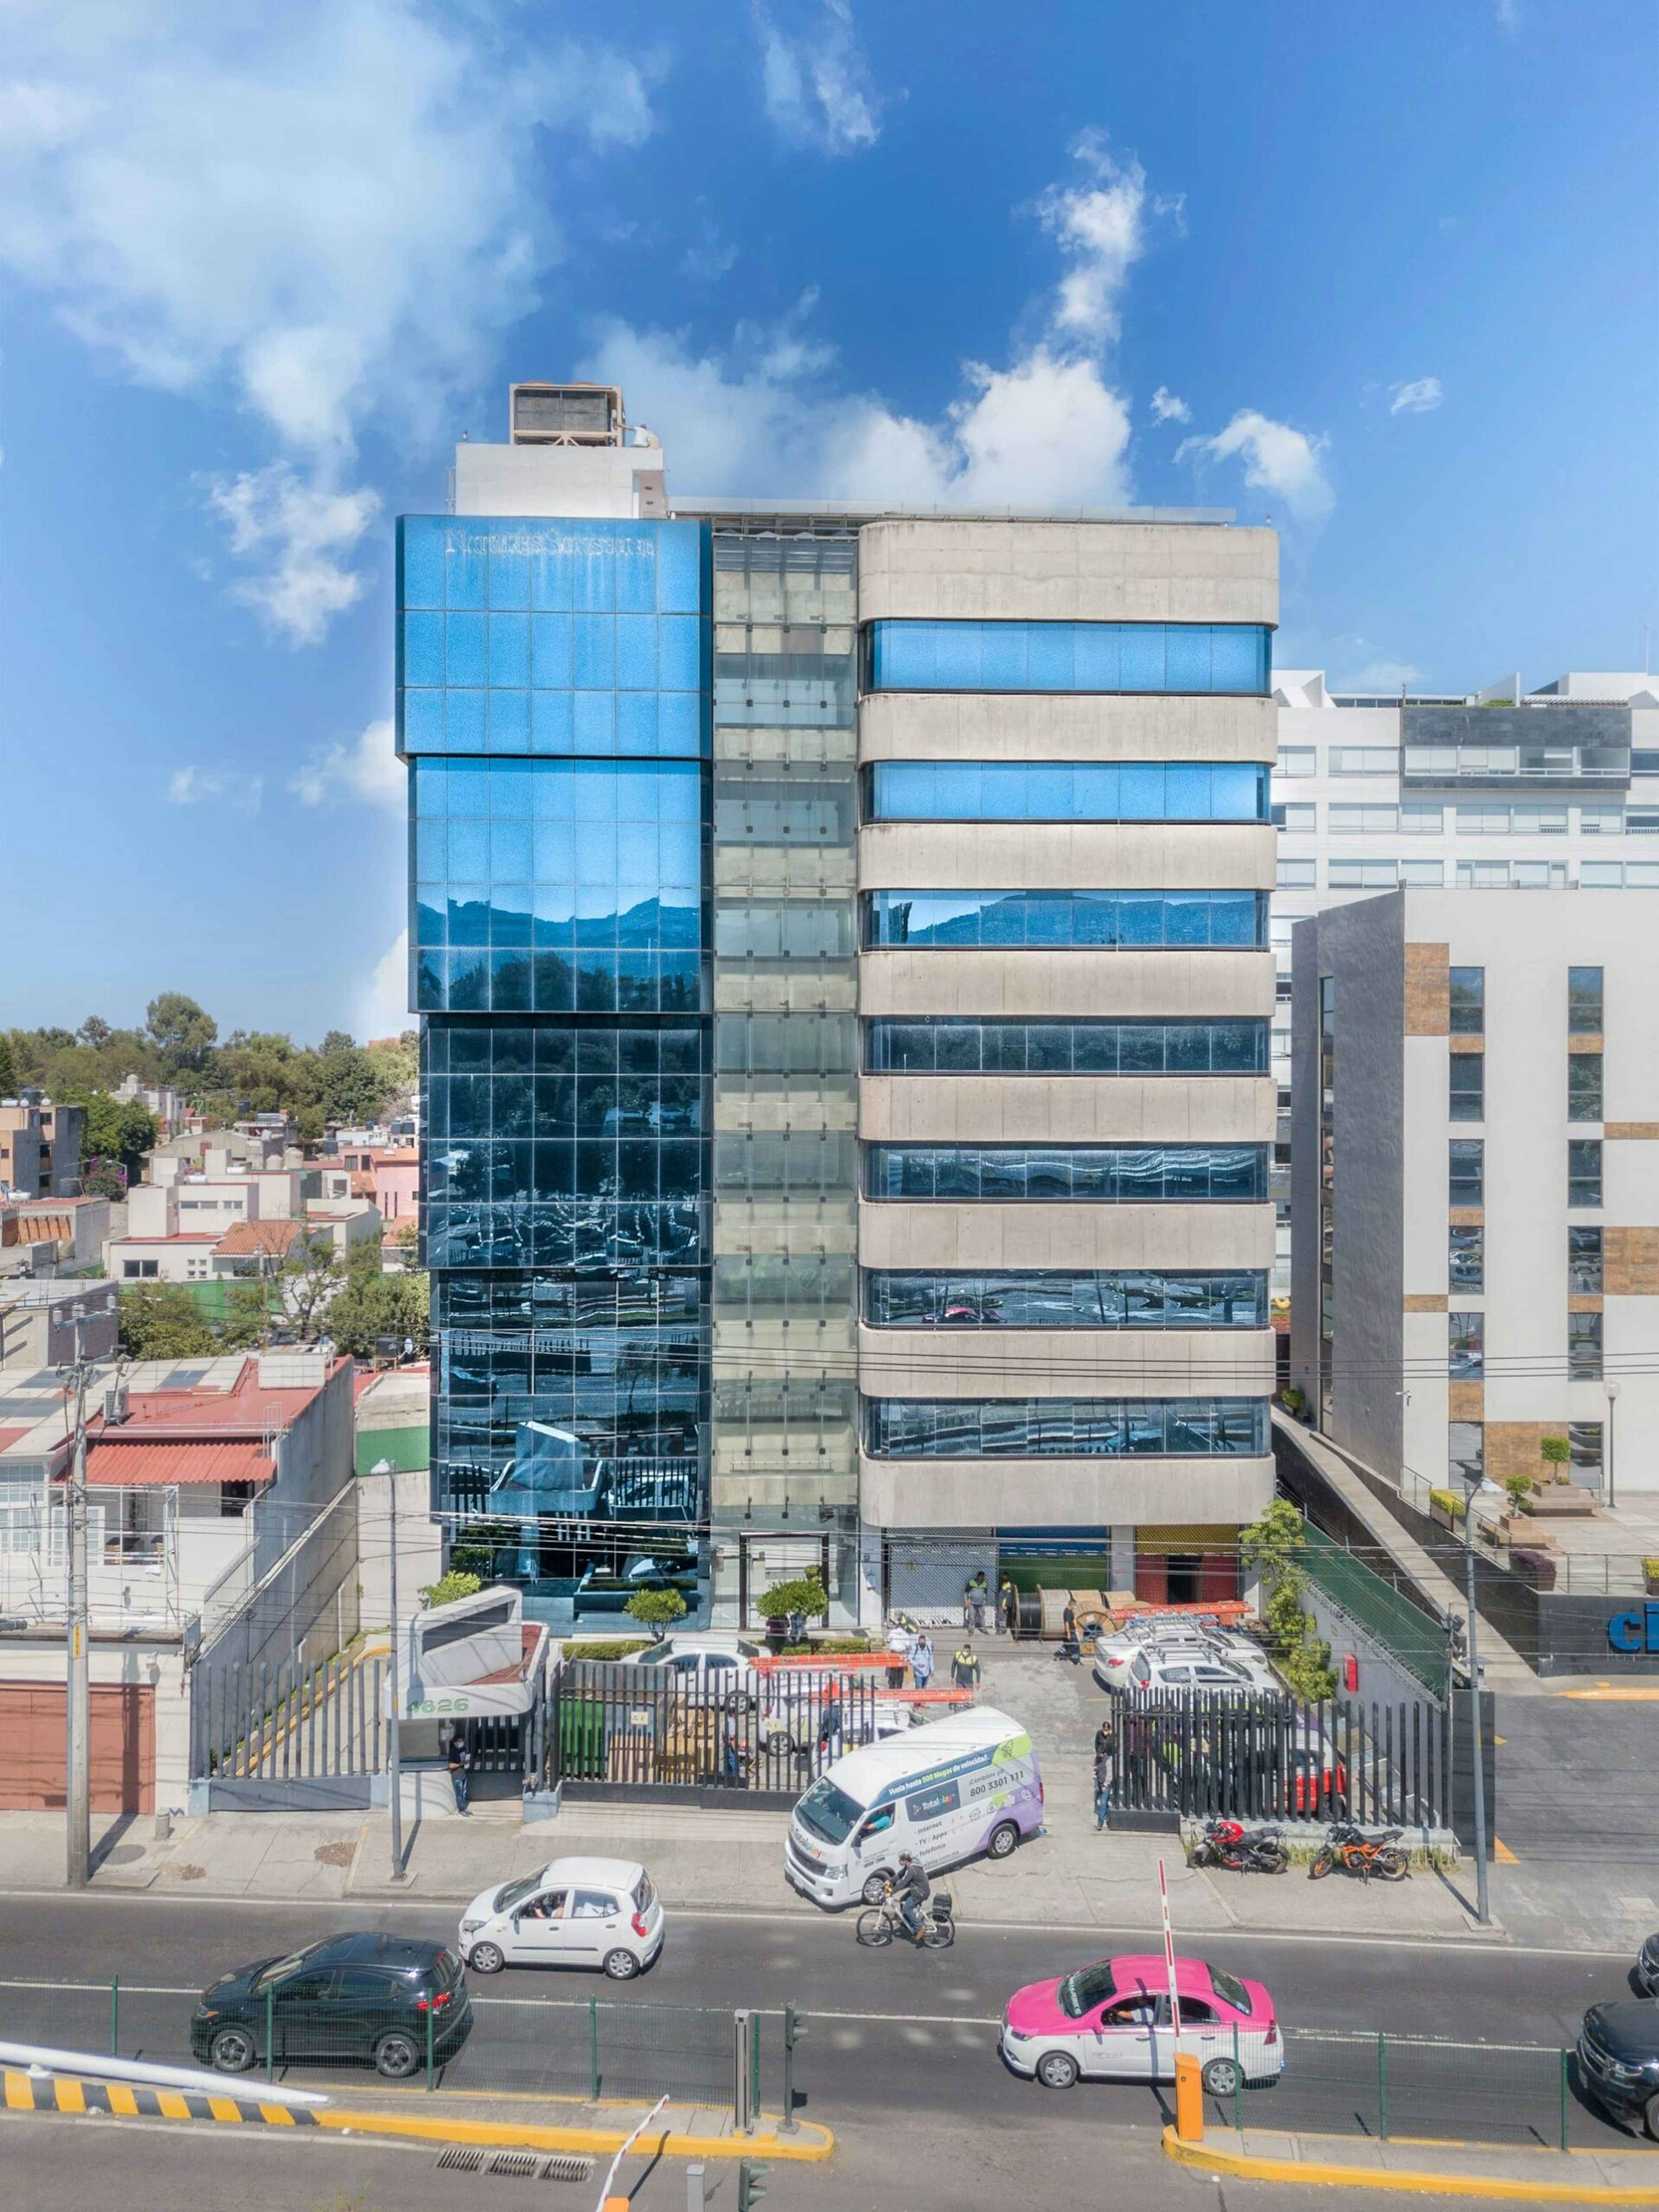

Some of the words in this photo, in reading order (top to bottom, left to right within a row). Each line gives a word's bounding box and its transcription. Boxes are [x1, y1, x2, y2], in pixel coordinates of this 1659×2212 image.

[406, 1698, 469, 1713] 4826
[953, 1764, 961, 1772] de
[970, 1784, 986, 1797] 800
[988, 1776, 1008, 1790] 3301
[1010, 1770, 1023, 1782] 111
[917, 1821, 942, 1834] Internet
[932, 1831, 947, 1841] Apps
